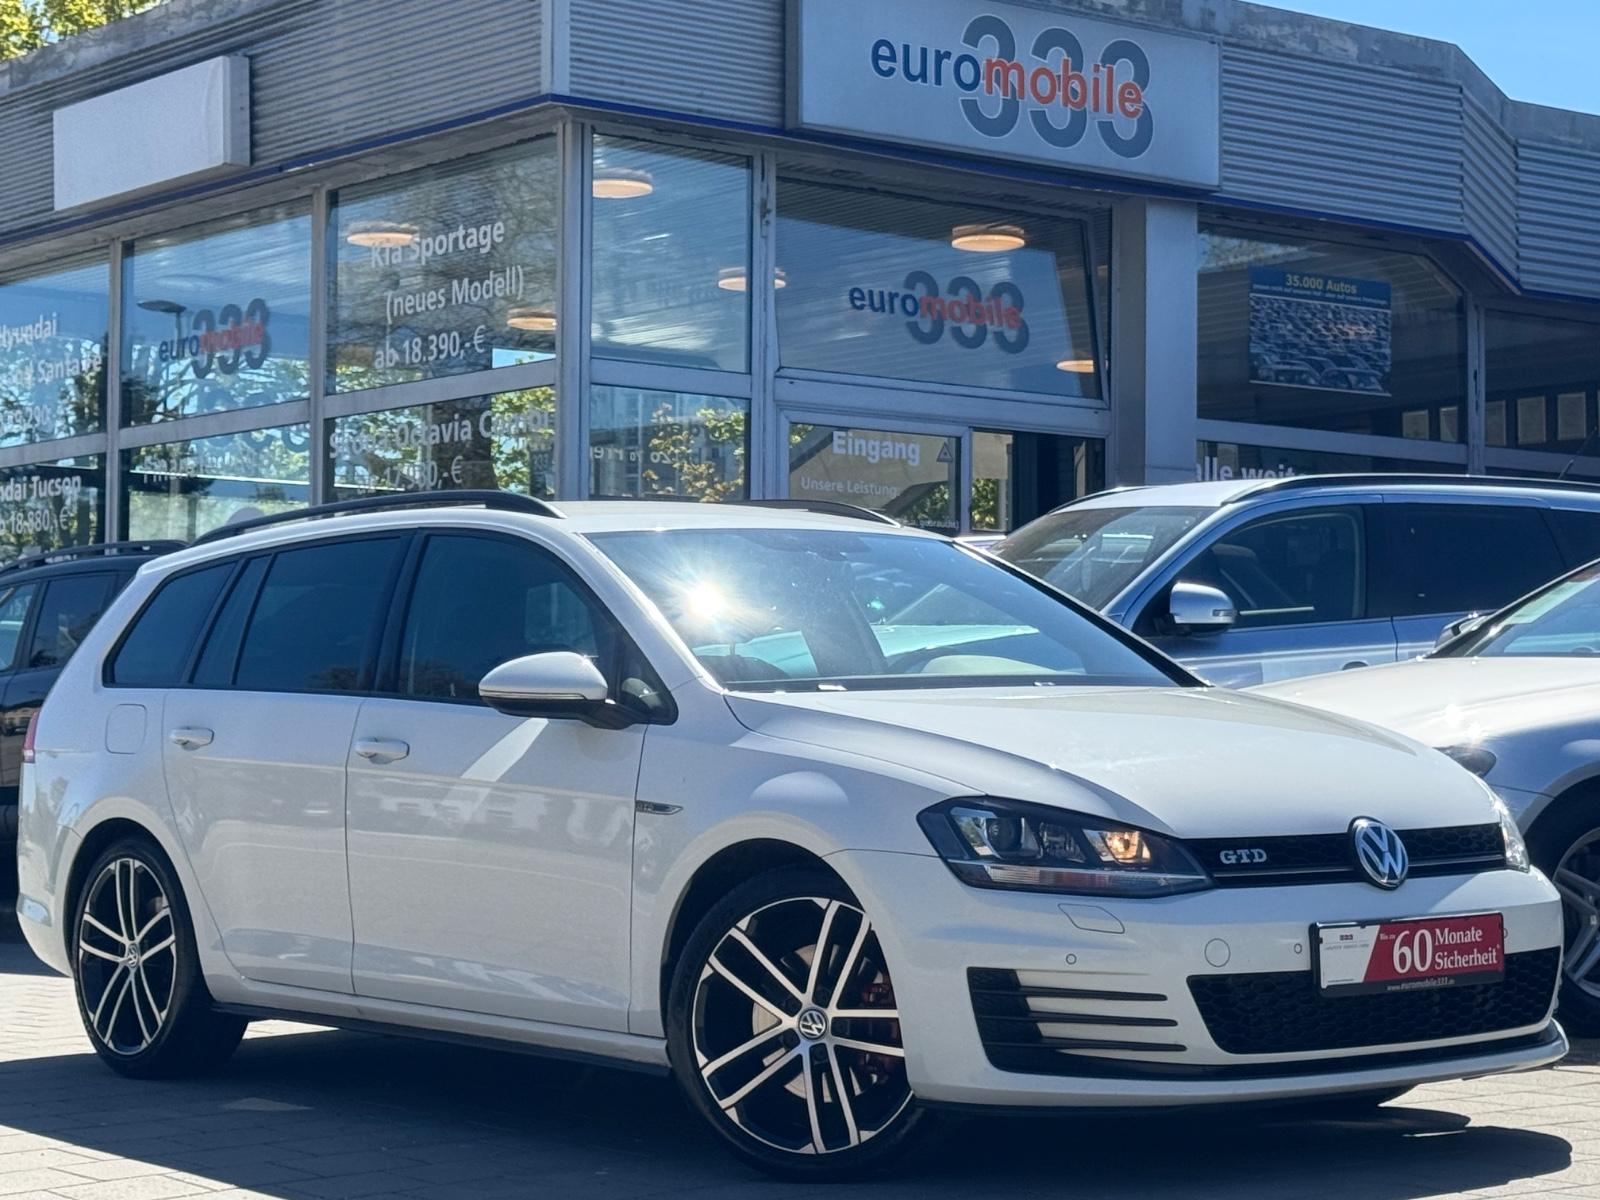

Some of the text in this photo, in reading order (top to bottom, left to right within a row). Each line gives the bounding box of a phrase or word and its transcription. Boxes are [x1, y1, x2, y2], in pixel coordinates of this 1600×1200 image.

[958, 13, 1154, 158] 333
[409, 221, 505, 266] Sportage
[385, 265, 524, 325] (neues Modell)
[1286, 273, 1357, 294] 35.000 Autos
[903, 270, 1029, 354] 333
[375, 339, 399, 369] ab
[832, 430, 921, 466] Eingang
[31, 475, 81, 500] Tucson
[801, 478, 844, 492] Unsere
[1219, 848, 1267, 864] GTD
[1393, 928, 1433, 974] 60
[1435, 926, 1483, 946] Monate
